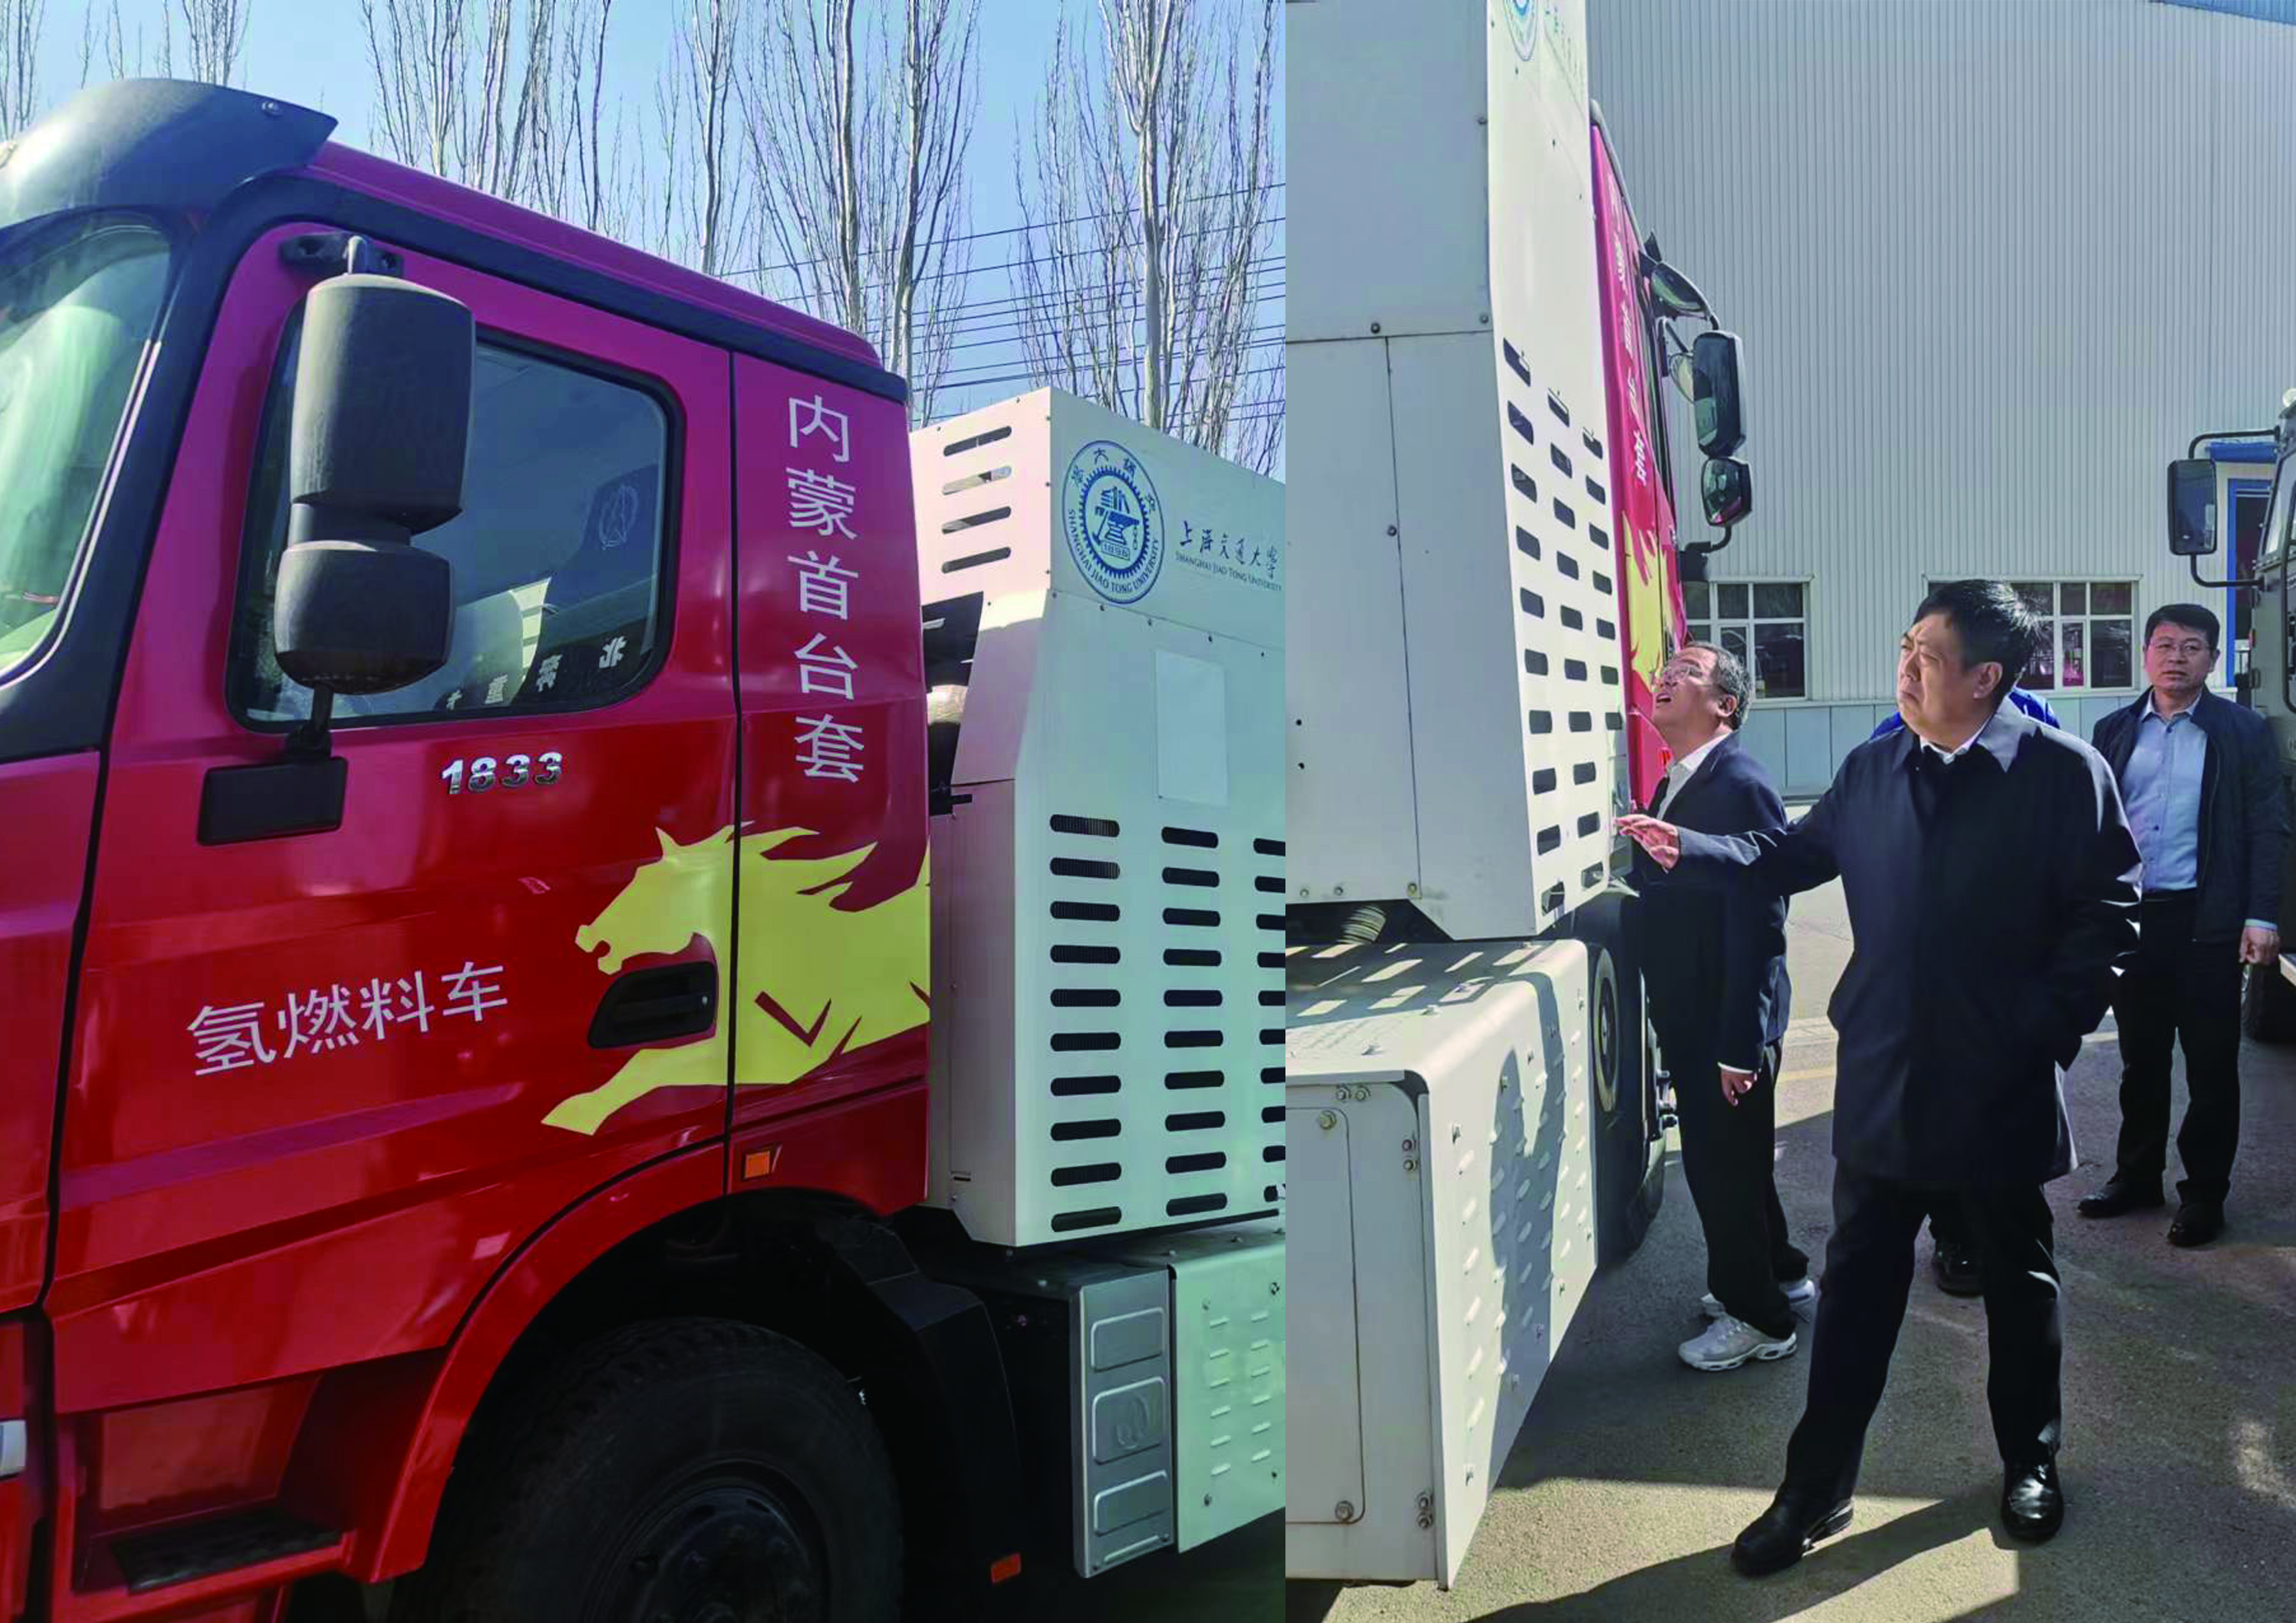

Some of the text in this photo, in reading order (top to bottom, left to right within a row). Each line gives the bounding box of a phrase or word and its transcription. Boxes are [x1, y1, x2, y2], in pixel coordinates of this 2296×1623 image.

[786, 395, 864, 783] 内蒙首台套
[1068, 510, 1160, 593] SHANGHAI JIAO TONG UNIVERSITY
[1175, 551, 1211, 571] SHANGHAI
[1213, 562, 1228, 575] JIAO
[1229, 568, 1247, 582] TONG
[440, 751, 564, 795] 1833
[187, 961, 509, 1077] 氢燃料车
